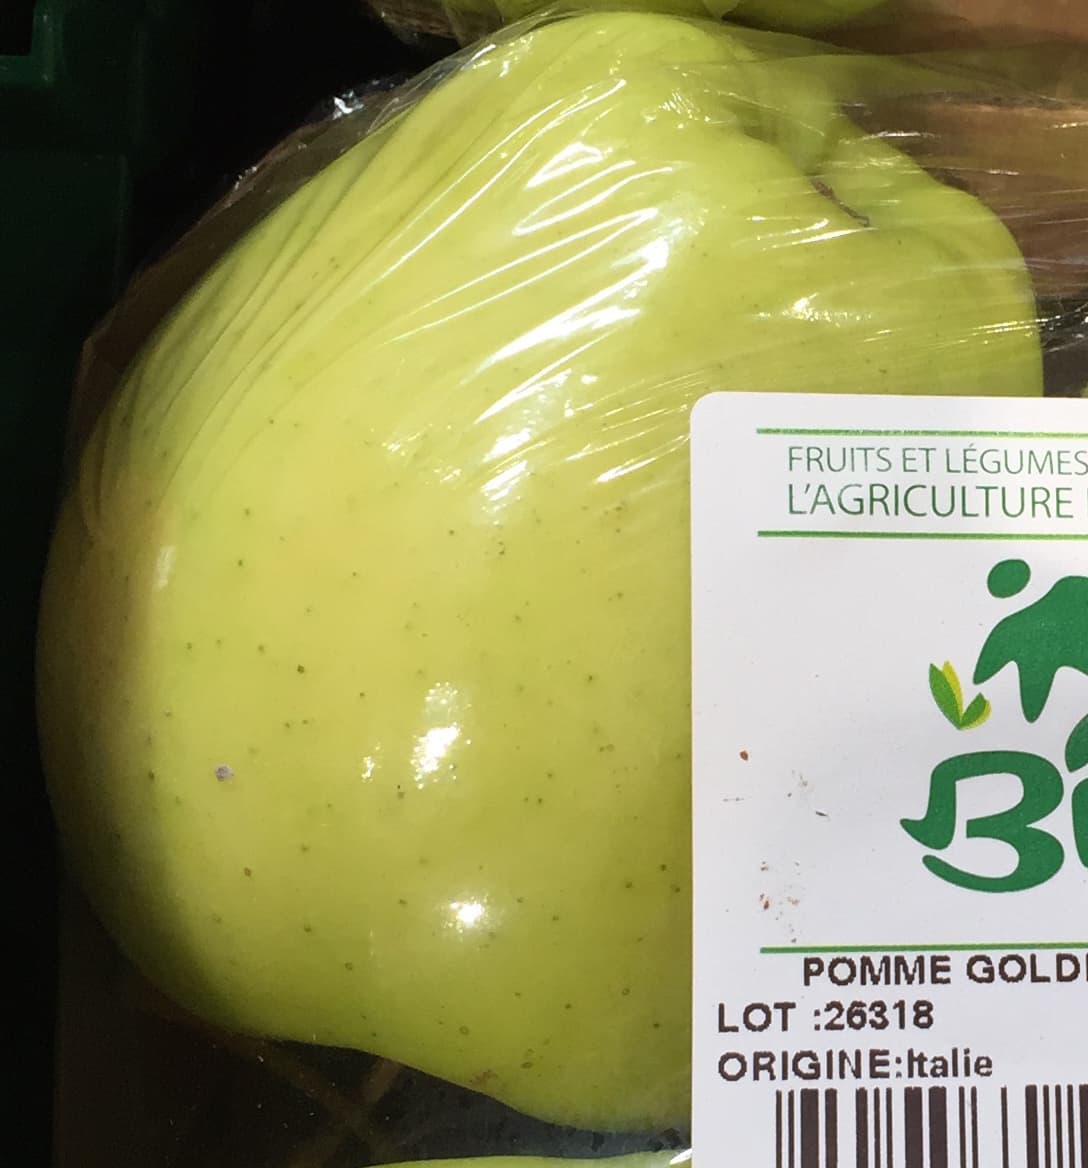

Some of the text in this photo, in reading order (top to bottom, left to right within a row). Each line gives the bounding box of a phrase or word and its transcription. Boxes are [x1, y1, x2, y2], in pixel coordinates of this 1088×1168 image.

[789, 446, 892, 472] FRUITS
[902, 448, 936, 472] ET
[946, 443, 1088, 475] LÉGUMES
[789, 483, 1074, 518] L'AGRICULTURE
[804, 955, 951, 987] POMME
[718, 1001, 796, 1033] LOT
